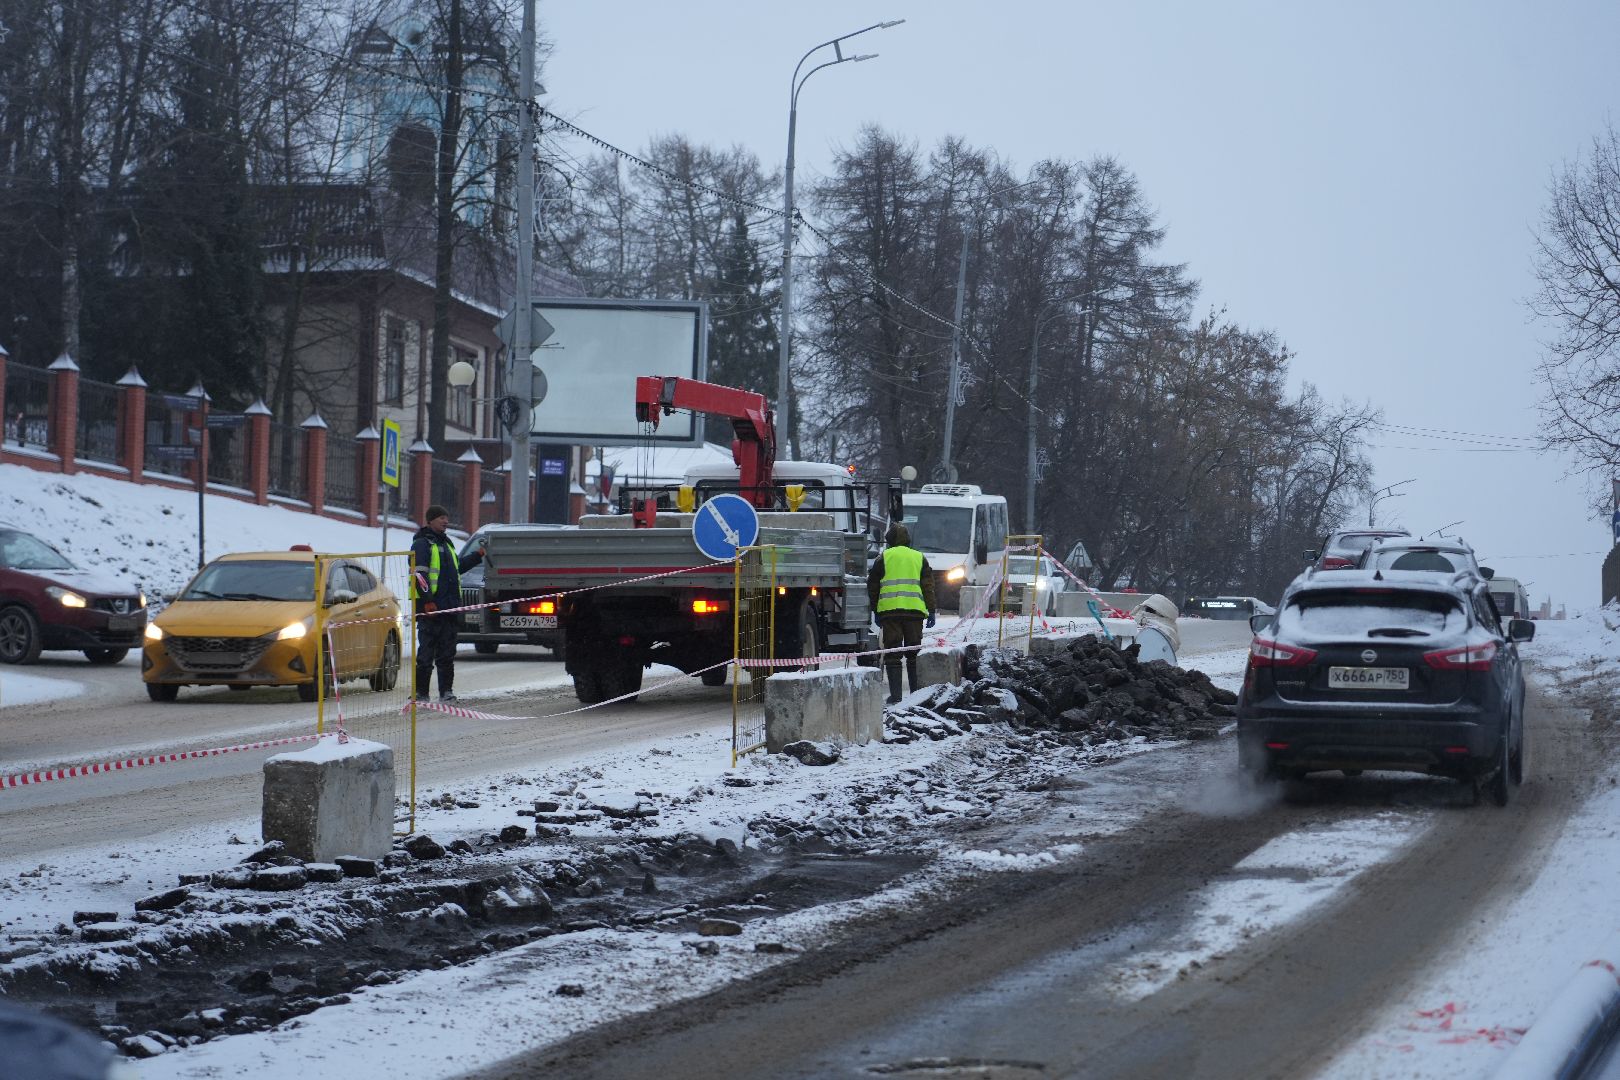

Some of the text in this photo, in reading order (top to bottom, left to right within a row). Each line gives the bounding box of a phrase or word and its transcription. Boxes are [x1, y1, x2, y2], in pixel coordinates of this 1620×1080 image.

[503, 616, 555, 627] С269УА 790
[1334, 670, 1405, 682] Х666АР 750
